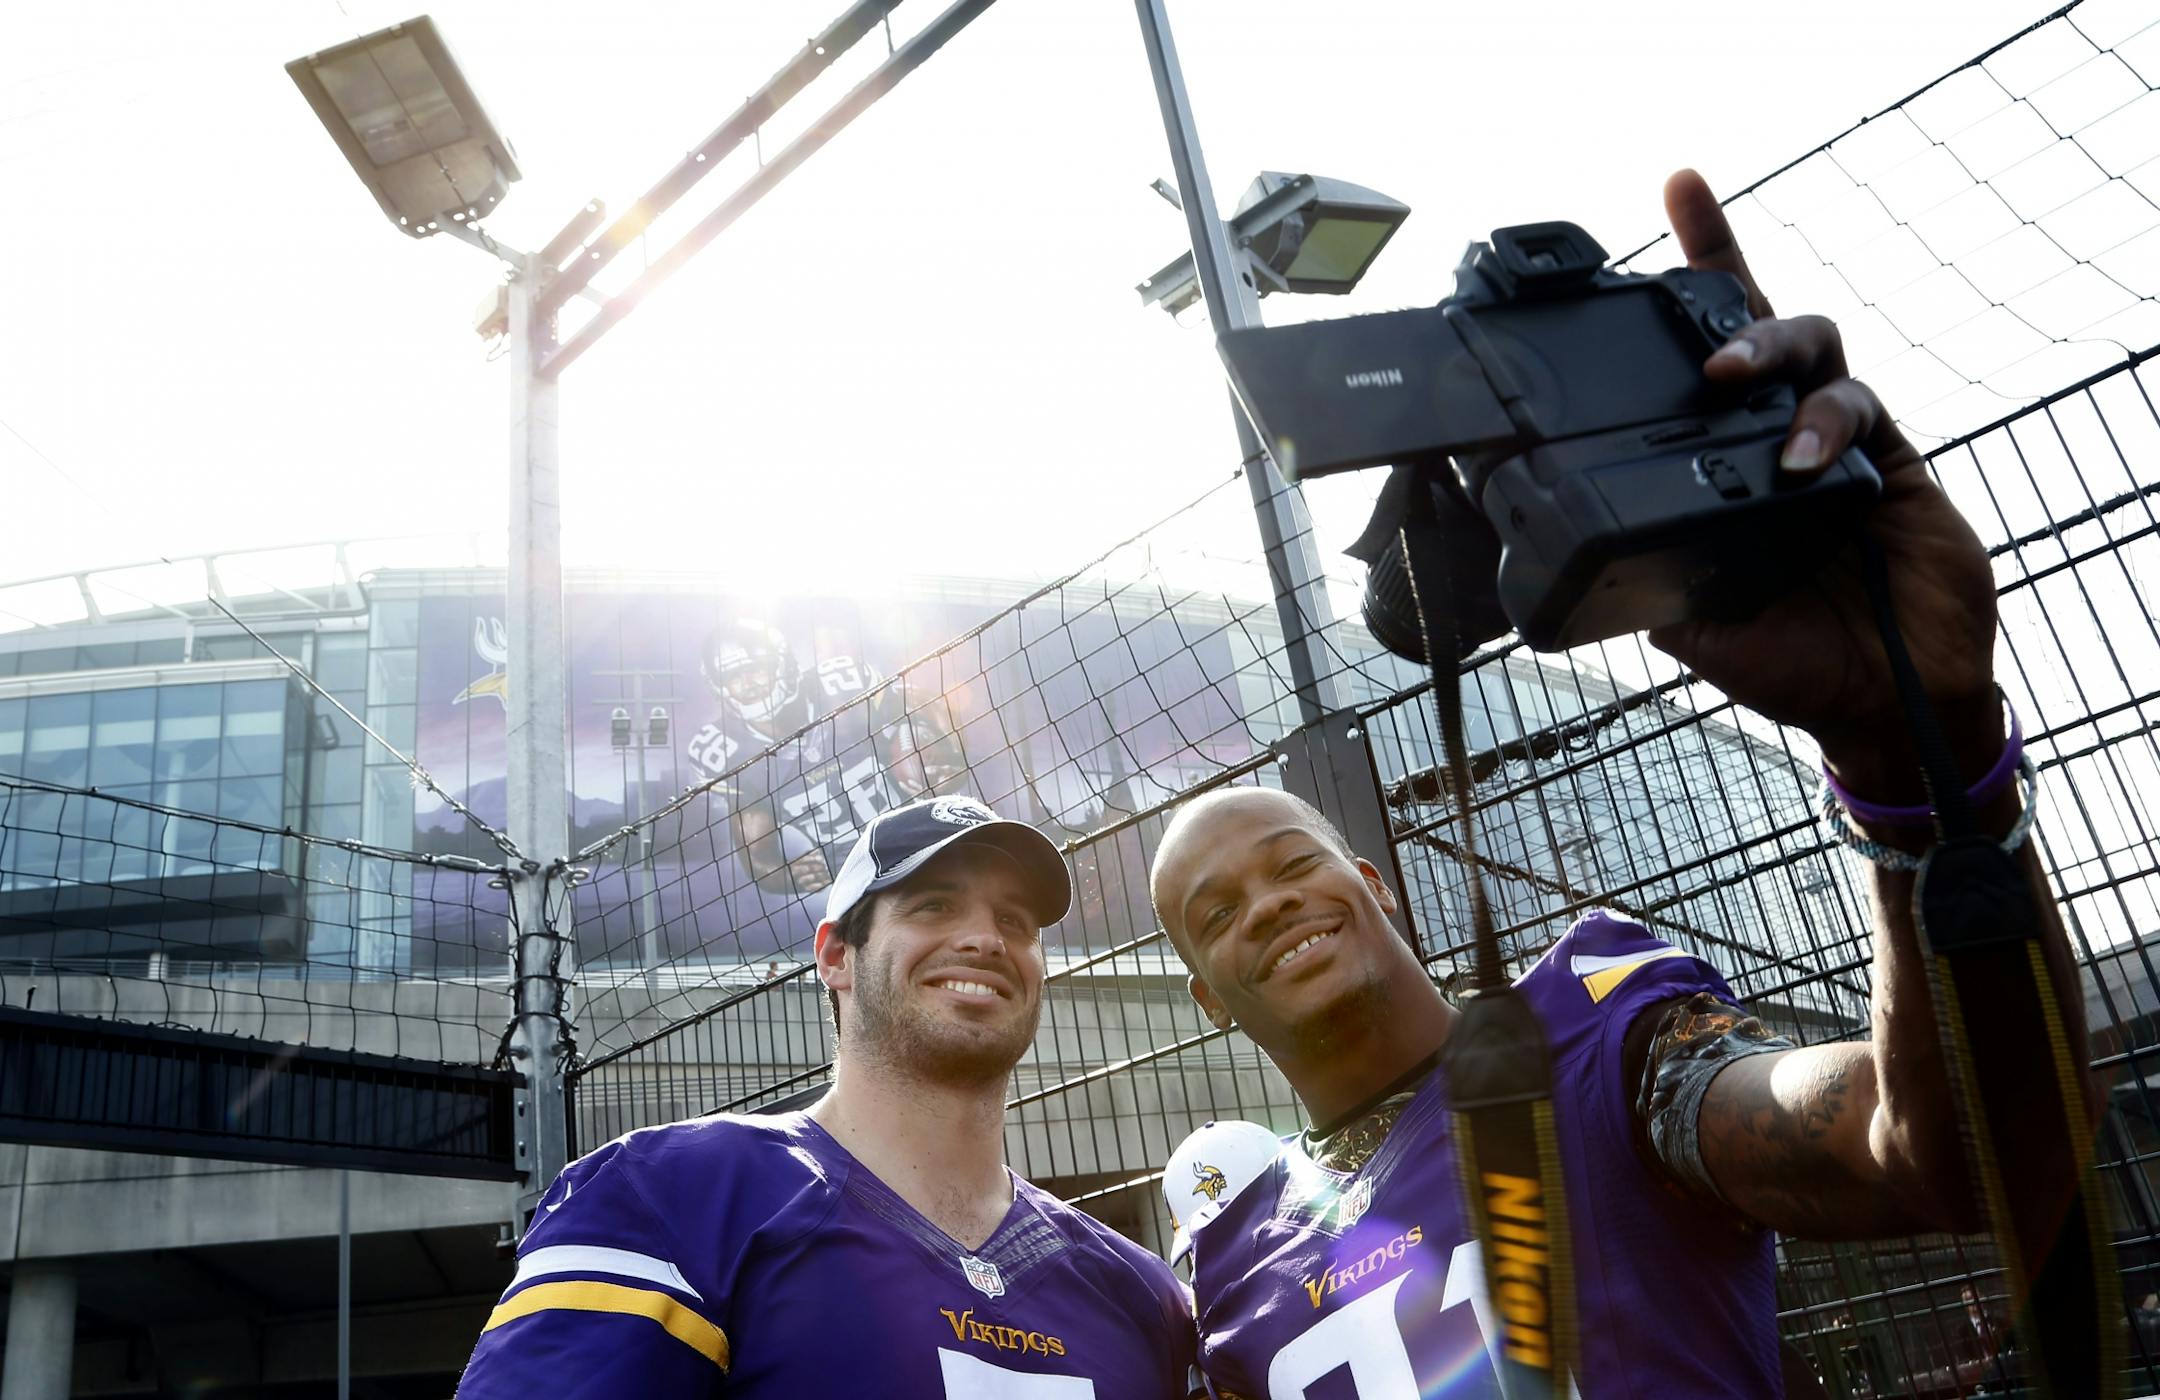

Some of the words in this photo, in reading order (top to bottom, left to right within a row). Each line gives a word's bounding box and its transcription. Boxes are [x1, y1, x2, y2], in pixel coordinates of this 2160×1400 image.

[1345, 367, 1403, 388] Nikon
[817, 656, 863, 696] 28
[688, 724, 738, 773] 28
[972, 1270, 1000, 1291] NFL
